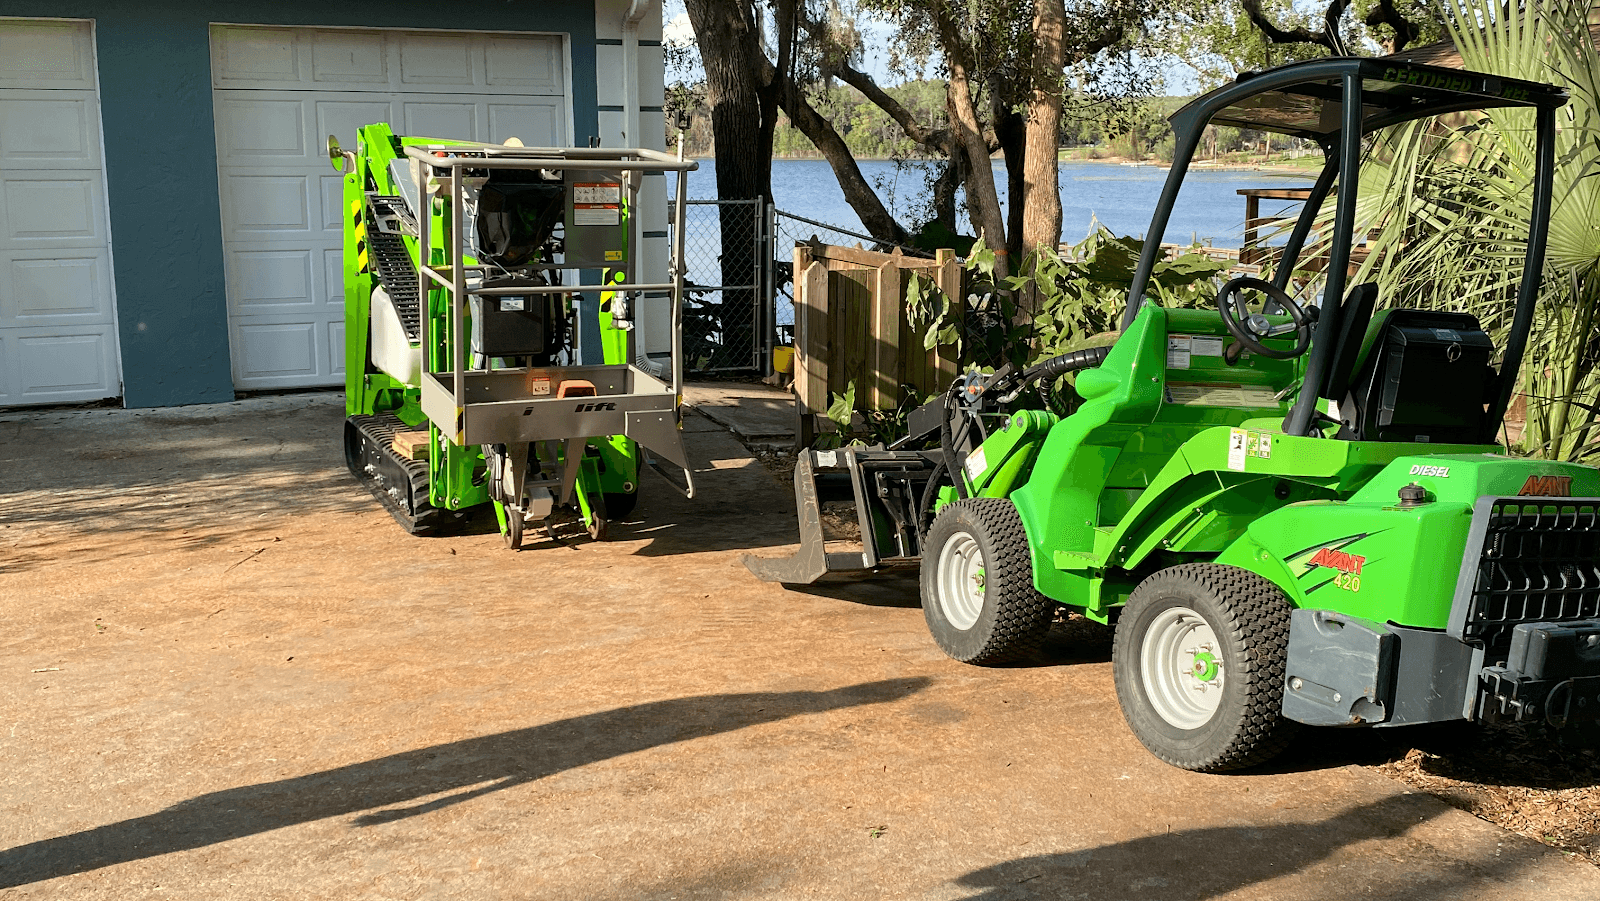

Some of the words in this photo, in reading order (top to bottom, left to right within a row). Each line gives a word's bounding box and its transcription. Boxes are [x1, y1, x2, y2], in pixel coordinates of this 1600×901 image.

[1383, 67, 1472, 92] CERTIFIED
[1495, 84, 1530, 100] REE
[575, 402, 617, 413] lift
[1409, 464, 1450, 478] DIESEL
[1517, 475, 1572, 497] AVANT
[1309, 548, 1366, 575] AVANT
[1333, 572, 1361, 593] 420
